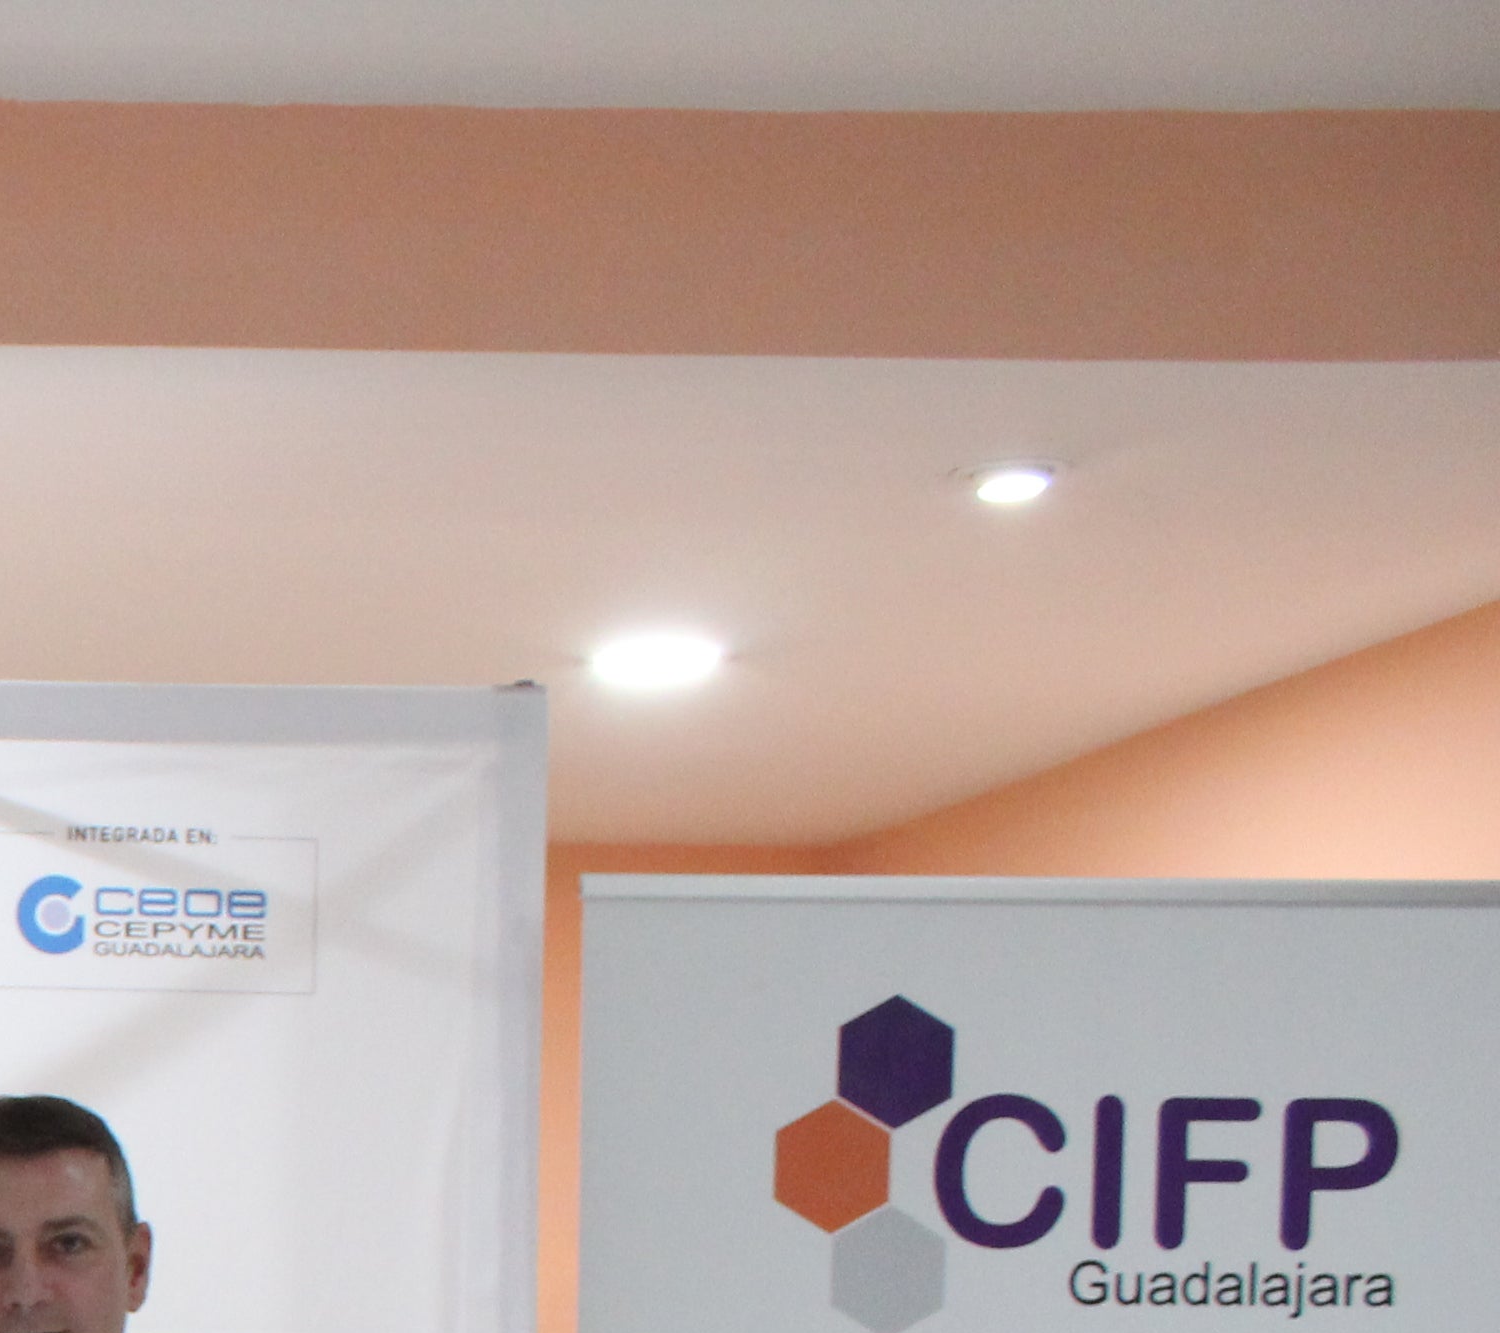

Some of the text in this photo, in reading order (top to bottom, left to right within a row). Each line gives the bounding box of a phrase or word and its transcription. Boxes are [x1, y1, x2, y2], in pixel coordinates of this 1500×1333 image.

[67, 826, 218, 846] INTEGRADA EN:
[93, 920, 266, 941] CEPYME
[93, 941, 266, 960] GUADALAJARA
[933, 1093, 1400, 1250] CIFP
[1068, 1259, 1396, 1318] Guadalajara
